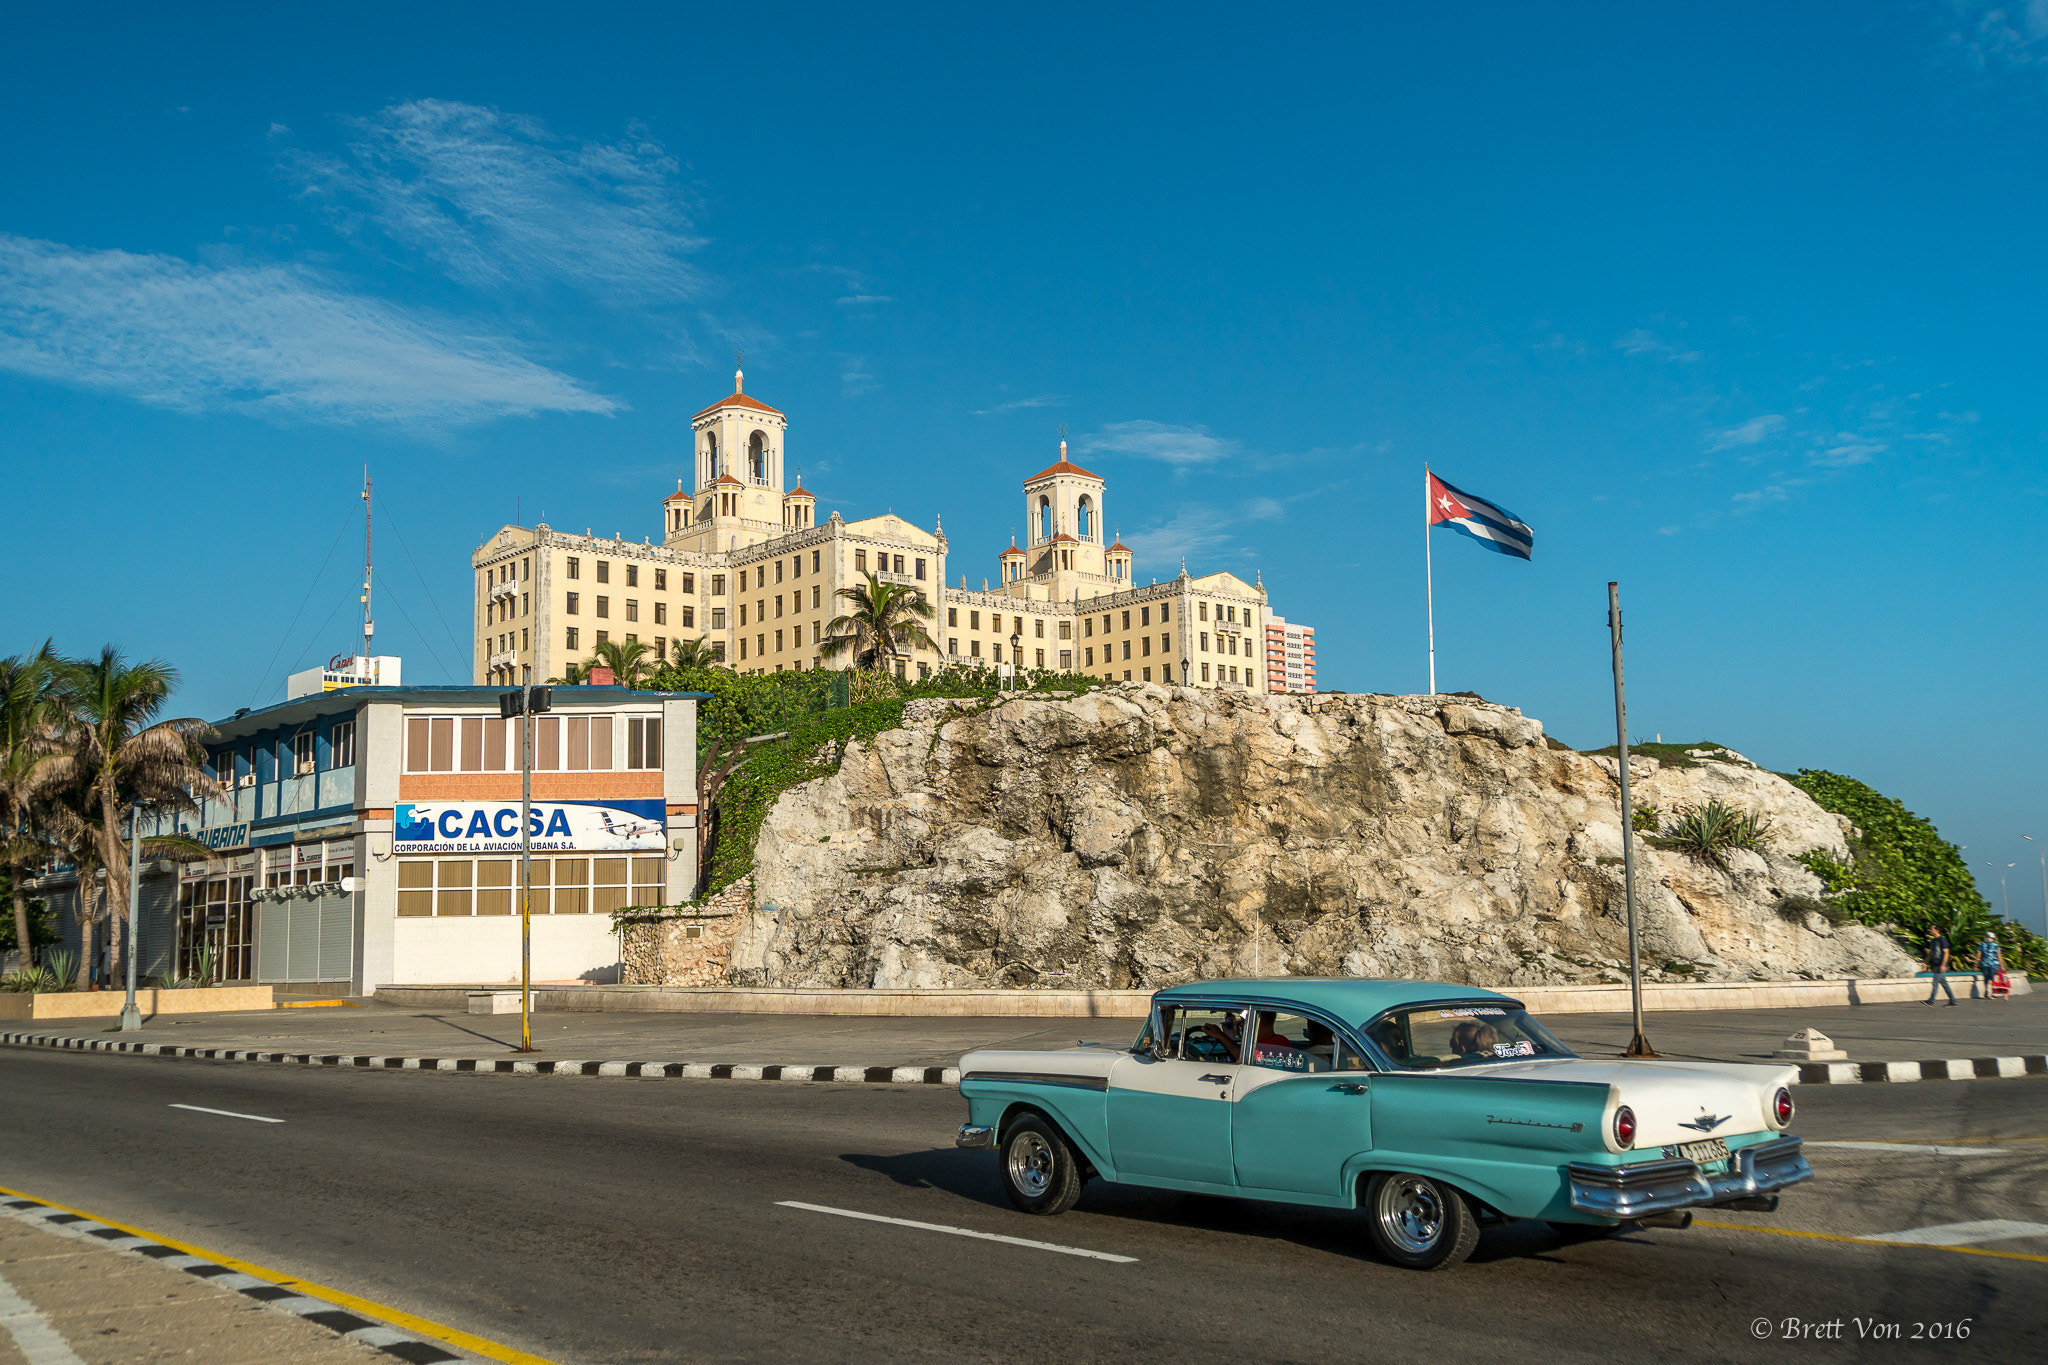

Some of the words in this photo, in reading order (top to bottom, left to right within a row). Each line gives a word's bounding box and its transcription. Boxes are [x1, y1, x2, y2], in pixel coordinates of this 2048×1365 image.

[438, 808, 572, 838] CACSA
[394, 842, 454, 852] CORPORACIÓN
[456, 843, 467, 851] DE
[469, 842, 480, 851] LA
[483, 841, 523, 851] AVIACIÓN
[530, 842, 558, 850] UBANA
[561, 841, 577, 850] S.A.
